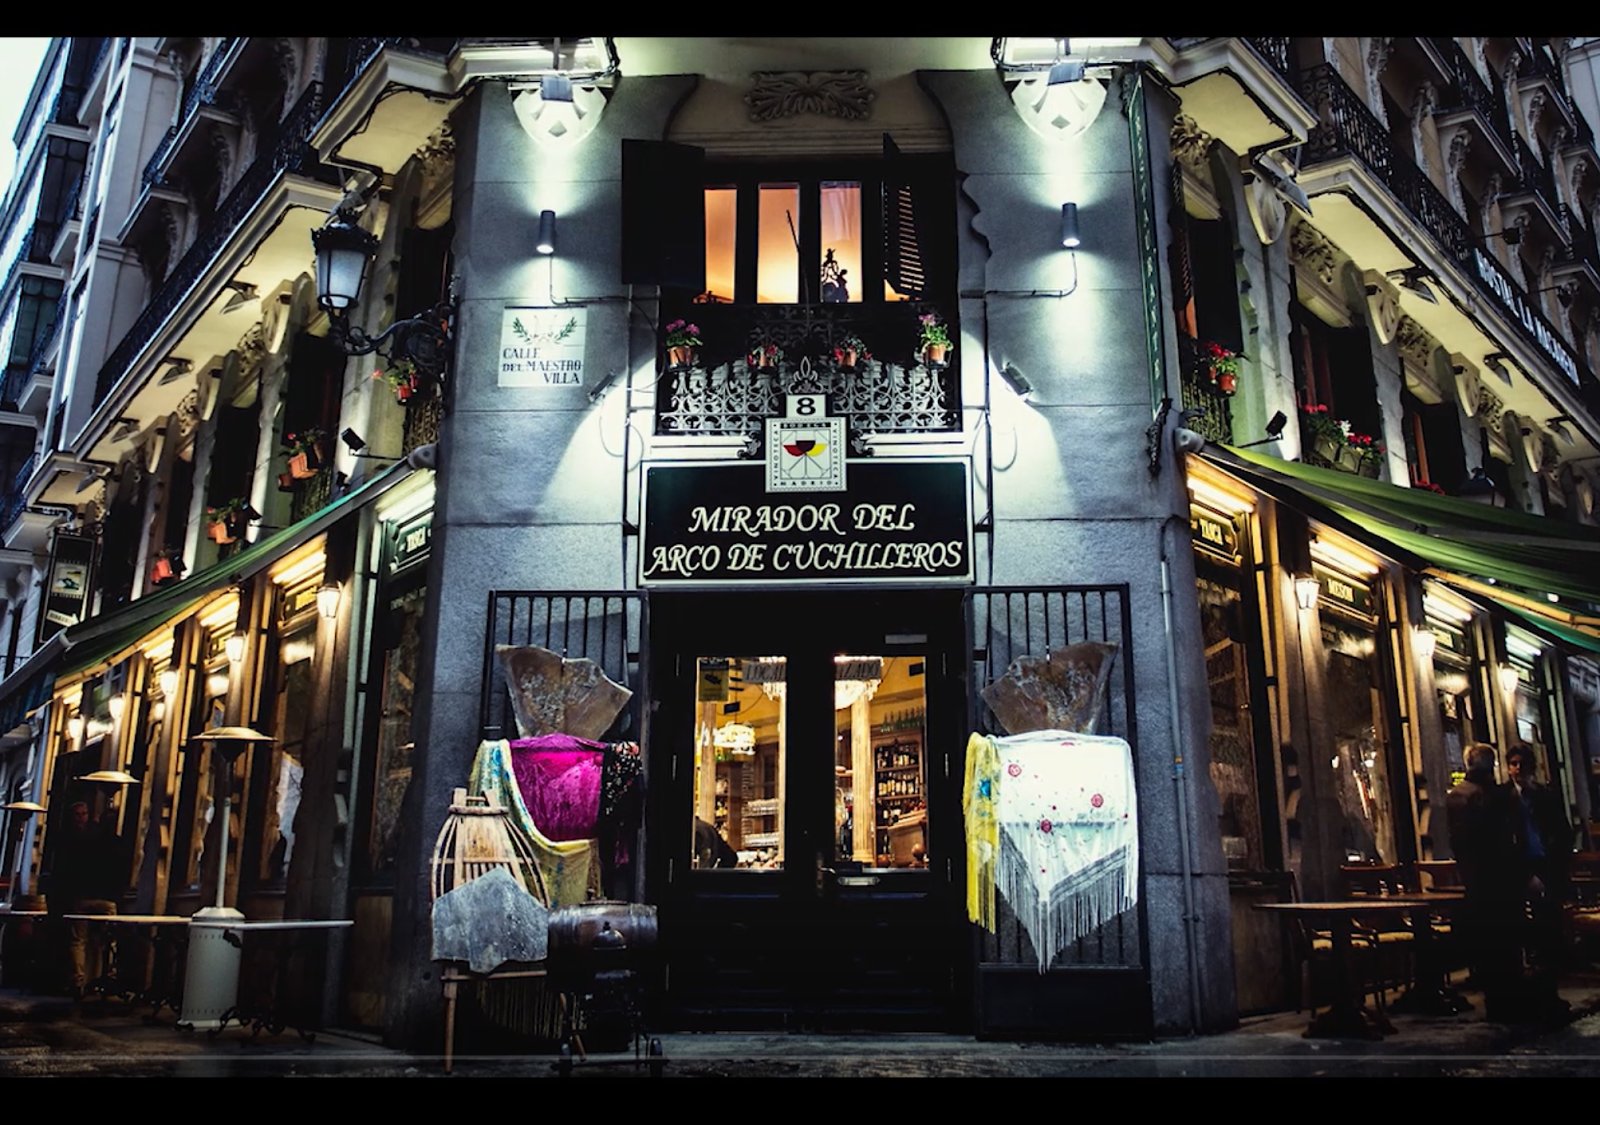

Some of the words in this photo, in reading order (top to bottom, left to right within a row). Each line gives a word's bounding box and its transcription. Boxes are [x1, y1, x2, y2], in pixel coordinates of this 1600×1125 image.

[503, 347, 541, 359] CALLE
[502, 363, 523, 372] DEL
[527, 359, 582, 372] MAESTRO
[543, 372, 580, 384] VILLA
[796, 397, 816, 416] 8
[687, 503, 847, 538] MIRADOR
[853, 503, 916, 531] DEL
[643, 543, 721, 577] ARCO
[726, 543, 767, 571] DE
[772, 540, 964, 573] CUCHILLEROS
